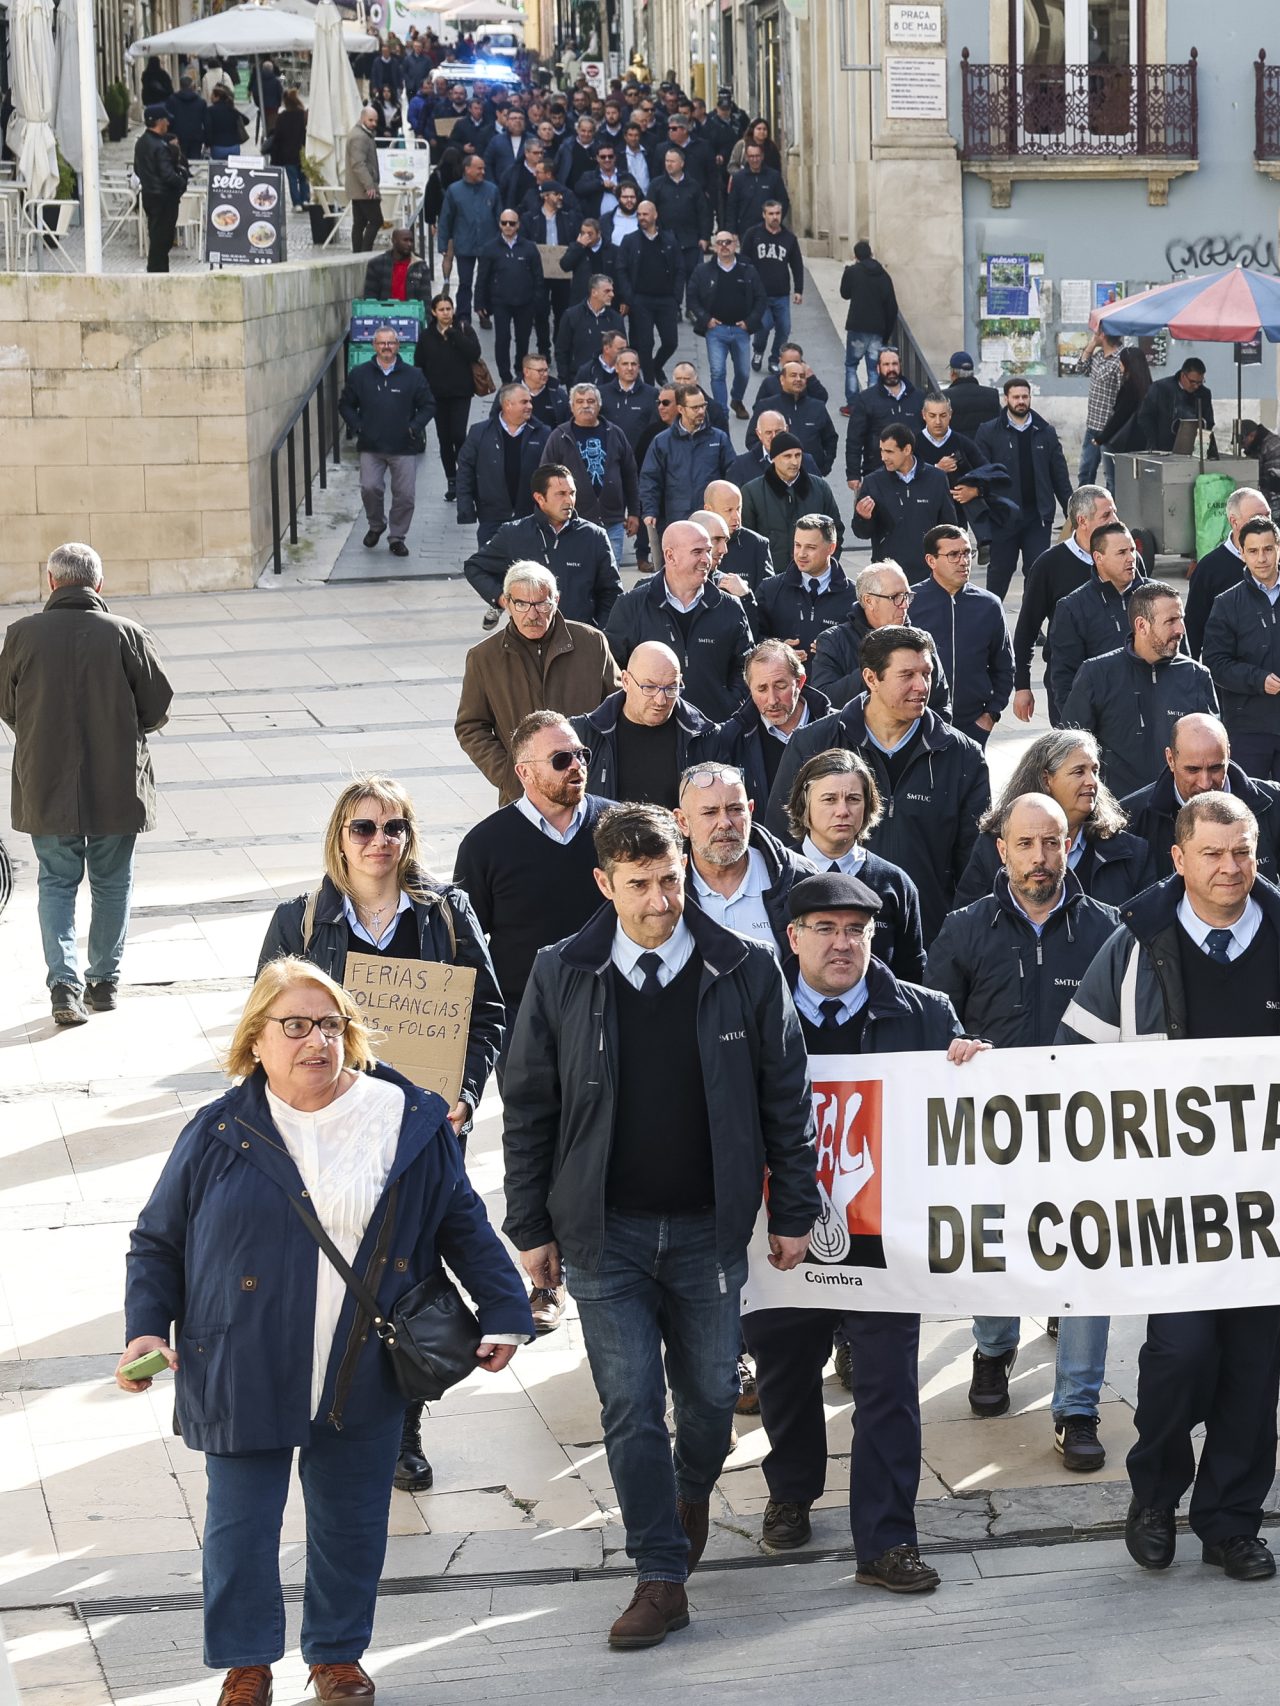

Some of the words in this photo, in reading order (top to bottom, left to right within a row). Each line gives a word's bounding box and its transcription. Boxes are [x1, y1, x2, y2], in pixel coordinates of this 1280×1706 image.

[894, 22, 899, 30] 8
[902, 22, 914, 30] DE
[917, 22, 937, 31] MAIO
[757, 243, 787, 261] GAP
[907, 792, 931, 802] SMTUC
[1054, 978, 1081, 987] SMTUC
[398, 1020, 446, 1039] FOLGA
[928, 1205, 1007, 1274] DE
[805, 1271, 863, 1286] Coimbra
